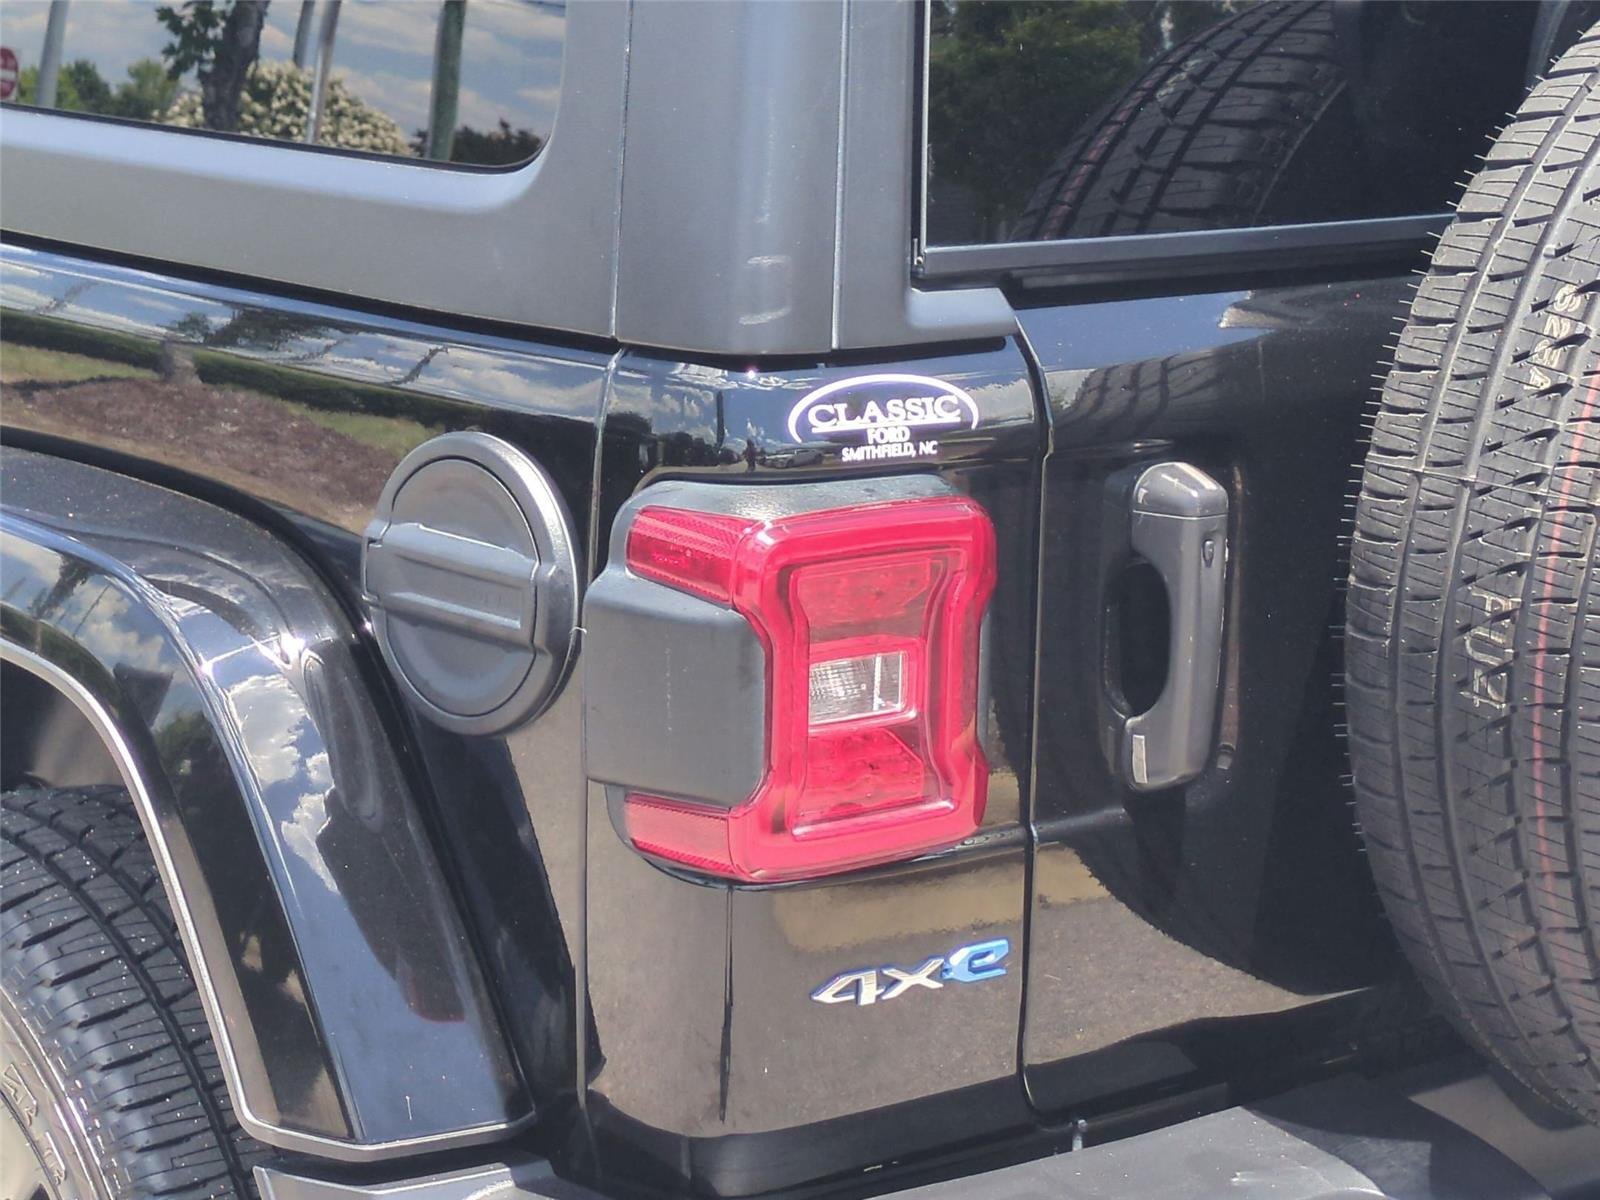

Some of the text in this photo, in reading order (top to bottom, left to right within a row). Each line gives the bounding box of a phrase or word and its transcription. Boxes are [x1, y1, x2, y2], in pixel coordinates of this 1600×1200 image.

[807, 395, 961, 428] CLASSIC
[866, 426, 911, 445] FORD
[841, 440, 939, 462] SMITHFIELD, NC
